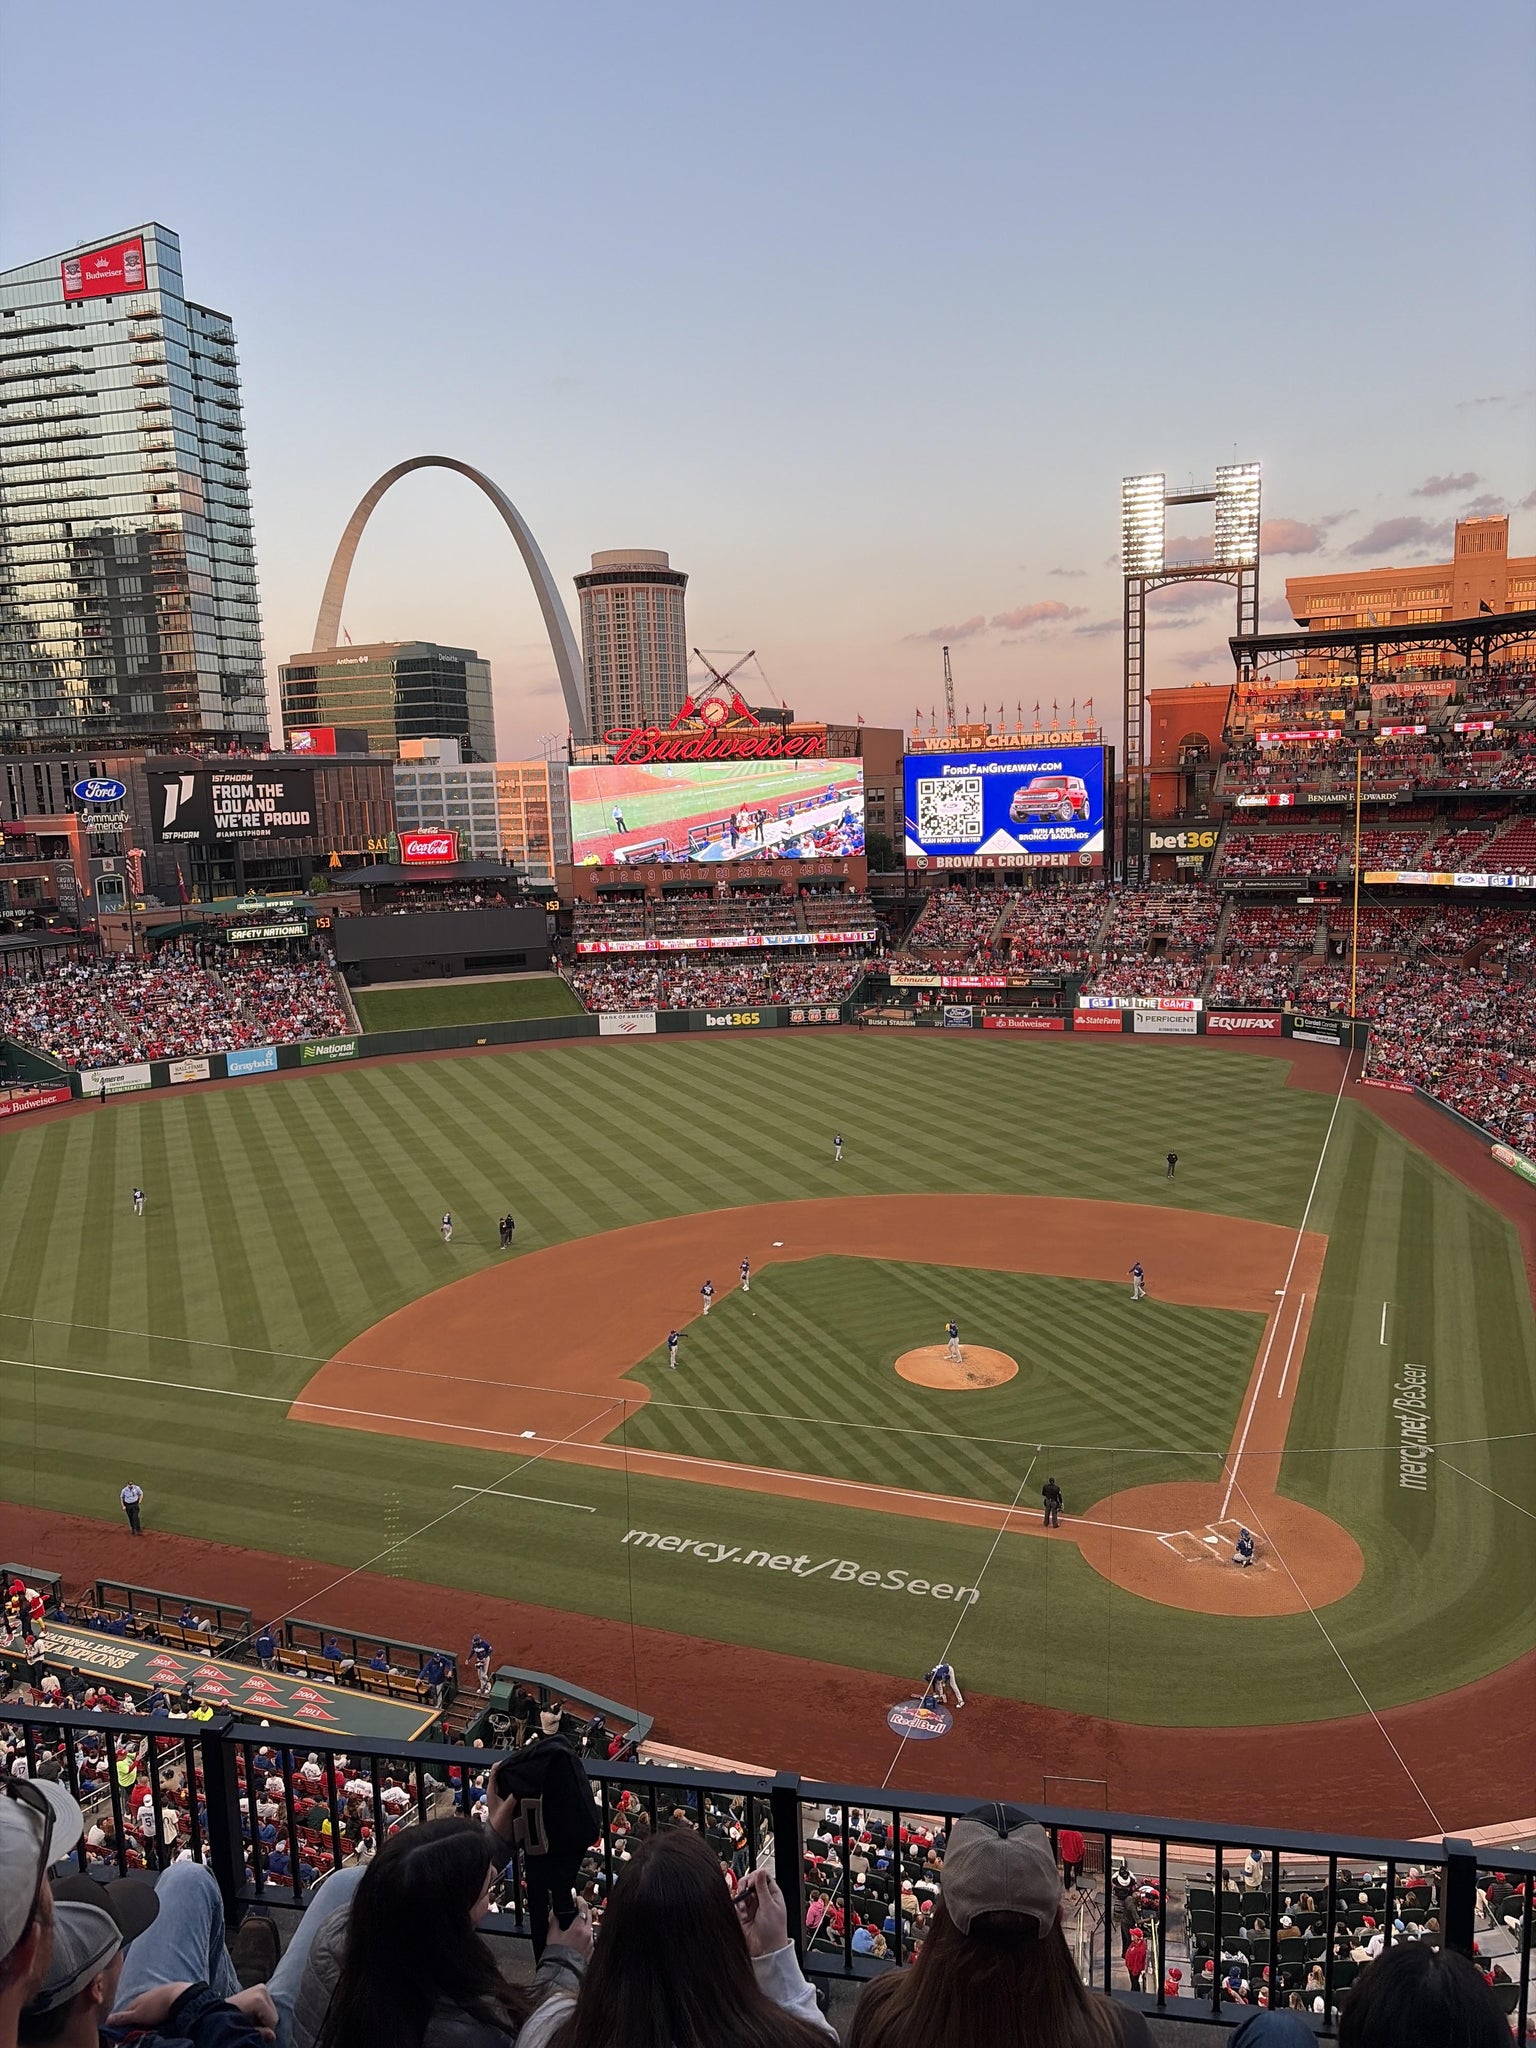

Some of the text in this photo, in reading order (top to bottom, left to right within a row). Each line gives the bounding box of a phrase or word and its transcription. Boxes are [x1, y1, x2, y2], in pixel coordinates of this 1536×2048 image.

[85, 269, 123, 280] Budweiser
[336, 655, 357, 665] Anthem
[1403, 683, 1452, 692] BUDWEISER
[603, 726, 827, 765] Budweiser
[923, 731, 1084, 750] WORLD CHAMPIONS
[85, 780, 117, 798] Ford
[212, 784, 284, 799] FROM THE
[1307, 794, 1347, 802] BENJAMIN
[1349, 793, 1356, 801] F.
[213, 798, 275, 814] LOU AND
[81, 811, 129, 823] Community
[214, 811, 310, 829] WE'RE PROUD
[936, 854, 1069, 868] BROWN & CROUPPEN
[647, 870, 655, 881] 9
[680, 868, 691, 880] 14
[698, 868, 709, 879] 17
[758, 865, 772, 877] 24
[779, 865, 793, 876] 42
[800, 864, 814, 875] 45
[819, 863, 832, 875] 85
[1491, 876, 1509, 885] GET
[1519, 876, 1529, 885] IN
[3, 910, 14, 918] FOR
[231, 926, 304, 939] SAFETY NATIONAL
[1092, 998, 1190, 1009] GET IN THE GAME
[706, 1012, 760, 1027] bet365
[1008, 1018, 1051, 1028] Budweiser
[1145, 1015, 1195, 1023] PERFICIENT
[1208, 1016, 1275, 1031] EQUIFAX
[316, 1041, 355, 1055] National
[100, 1075, 125, 1084] Ameren
[12, 1095, 57, 1112] Budweiser
[1392, 1363, 1434, 1491] mercy.net/BeSeen
[620, 1528, 981, 1605] mercy.net/BeSeen
[92, 1642, 139, 1660] LEAGUE
[200, 1668, 218, 1677] 1943
[202, 1684, 222, 1693] 1968
[248, 1679, 266, 1688] 1985
[253, 1695, 271, 1704] 1987
[297, 1692, 316, 1701] 2004
[301, 1707, 320, 1716] 2013
[890, 1713, 946, 1734] Red Bull
